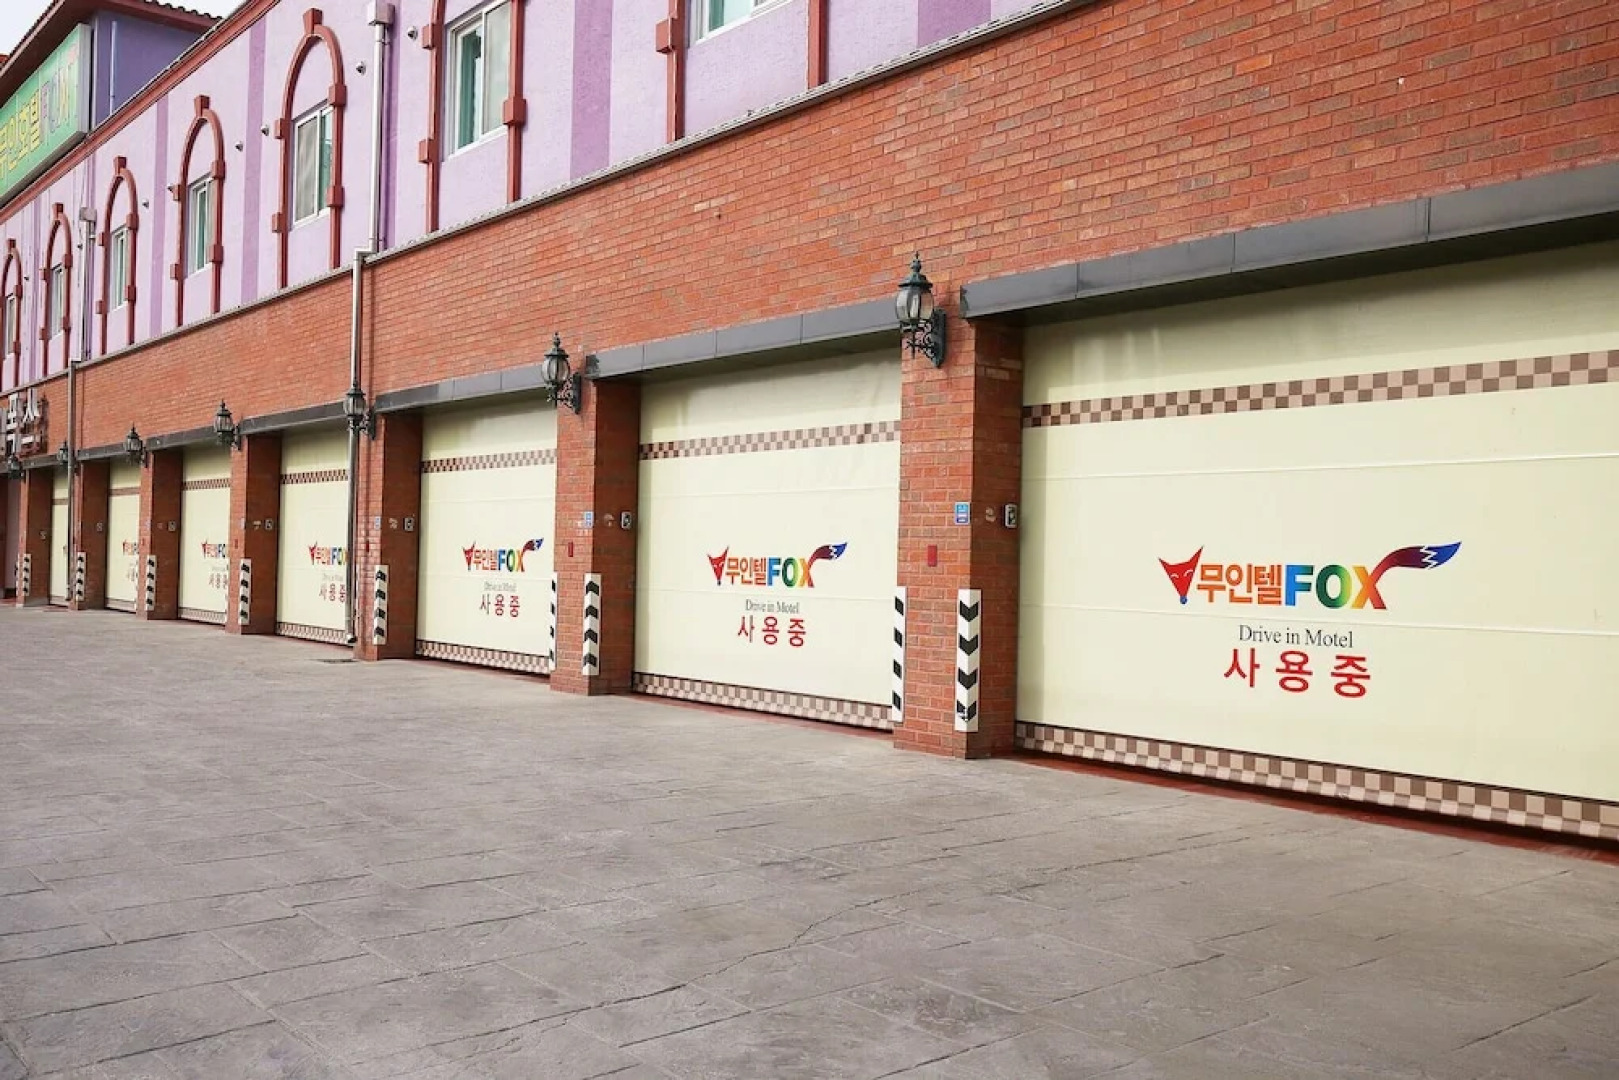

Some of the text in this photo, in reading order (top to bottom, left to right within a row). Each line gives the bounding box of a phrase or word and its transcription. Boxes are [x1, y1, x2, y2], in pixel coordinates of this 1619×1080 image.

[1239, 624, 1354, 648] Drive in Motel
